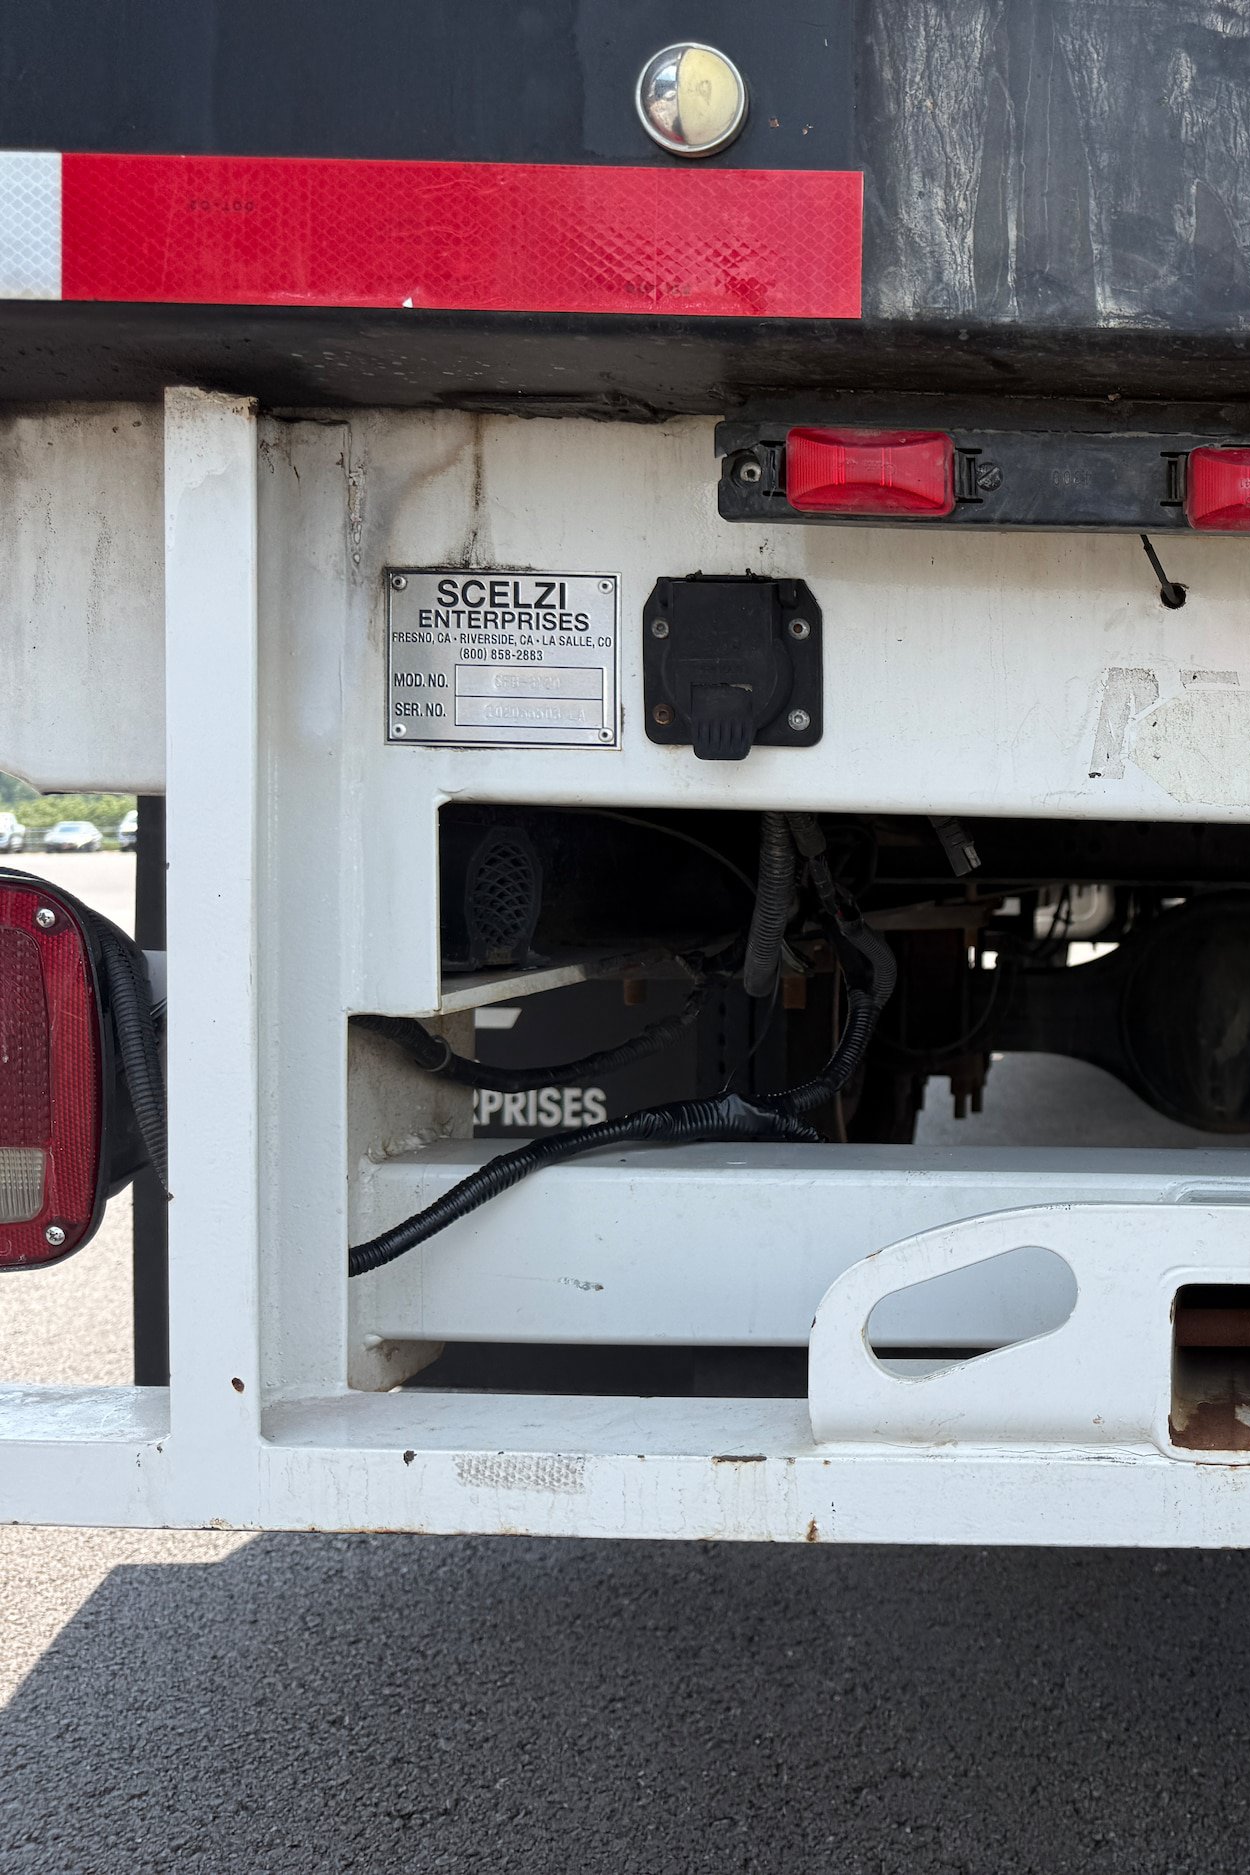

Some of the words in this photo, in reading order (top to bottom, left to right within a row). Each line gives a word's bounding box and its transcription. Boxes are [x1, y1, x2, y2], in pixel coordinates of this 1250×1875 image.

[436, 579, 567, 610] SCELZI
[418, 609, 590, 632] ENTERPRISES
[392, 632, 435, 646] FRESNO,
[437, 632, 451, 644] CA
[460, 633, 517, 646] RIVERSIDE,
[520, 634, 534, 645] CA
[542, 635, 556, 647] LA
[558, 636, 595, 648] SALLE,
[598, 636, 612, 648] CO
[459, 648, 487, 661] (800)
[491, 649, 543, 661] 858-2883
[394, 672, 426, 688] MOD.
[427, 673, 449, 689] NO.
[394, 702, 424, 717] SER.
[425, 702, 447, 718] NO.
